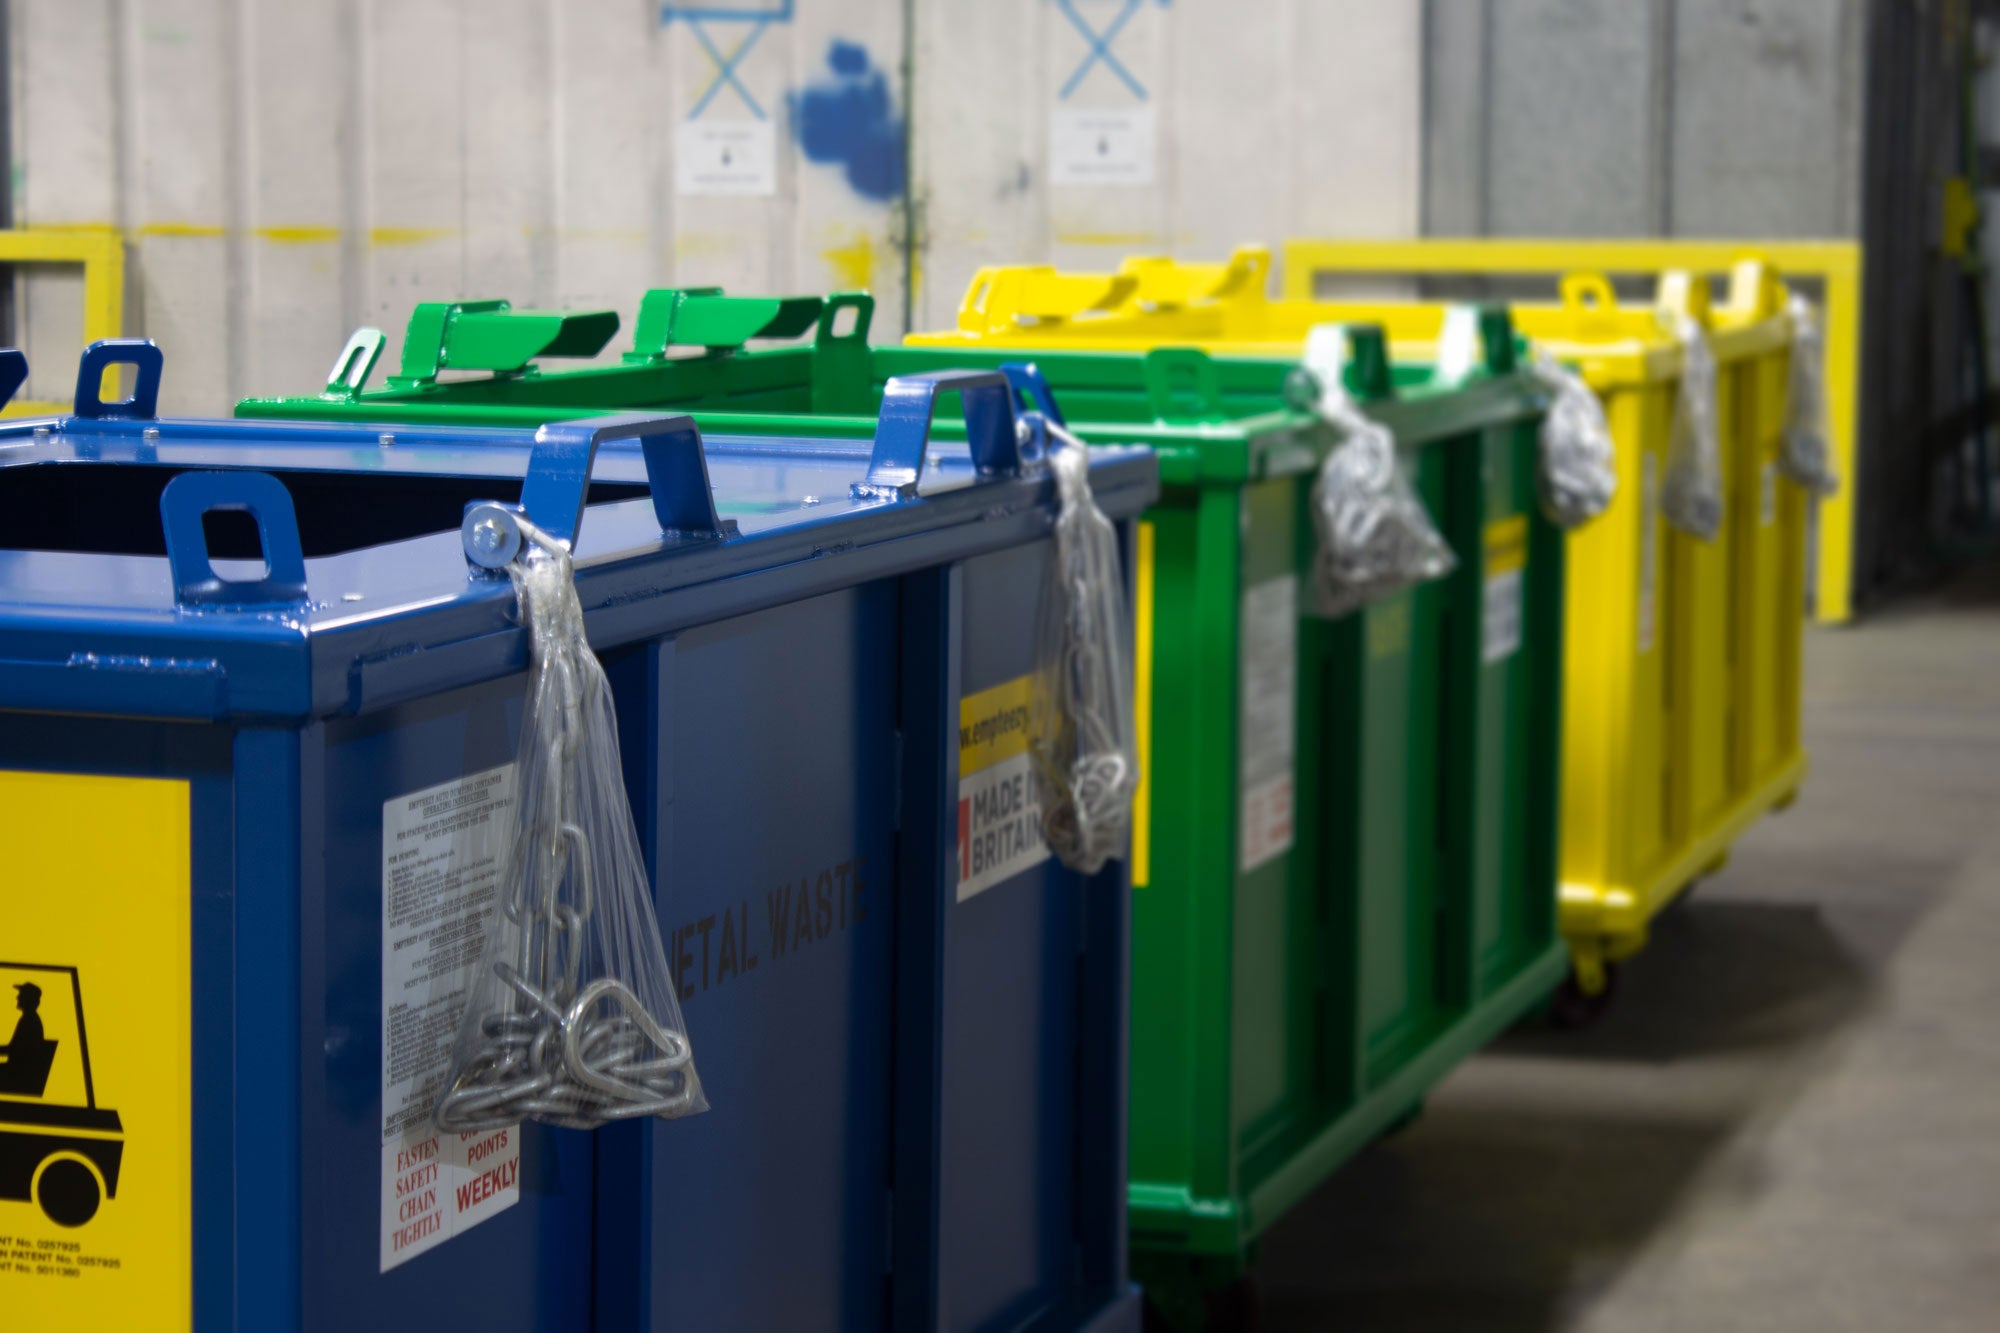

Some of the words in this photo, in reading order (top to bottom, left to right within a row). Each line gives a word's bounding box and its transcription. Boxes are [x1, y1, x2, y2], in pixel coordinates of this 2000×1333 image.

[973, 774, 1022, 833] MADE
[671, 900, 758, 1001] ETAL
[767, 855, 868, 960] WASTE
[396, 1135, 439, 1173] FASTEN
[467, 1129, 508, 1166] POINTS
[395, 1161, 440, 1200] SAFETY
[456, 1156, 519, 1213] WEEKLY
[399, 1188, 436, 1223] CHAIN
[16, 1239, 33, 1249] No.
[392, 1210, 443, 1253] TIGHTLY
[11, 1250, 53, 1262] PATENT
[55, 1254, 73, 1265] No.
